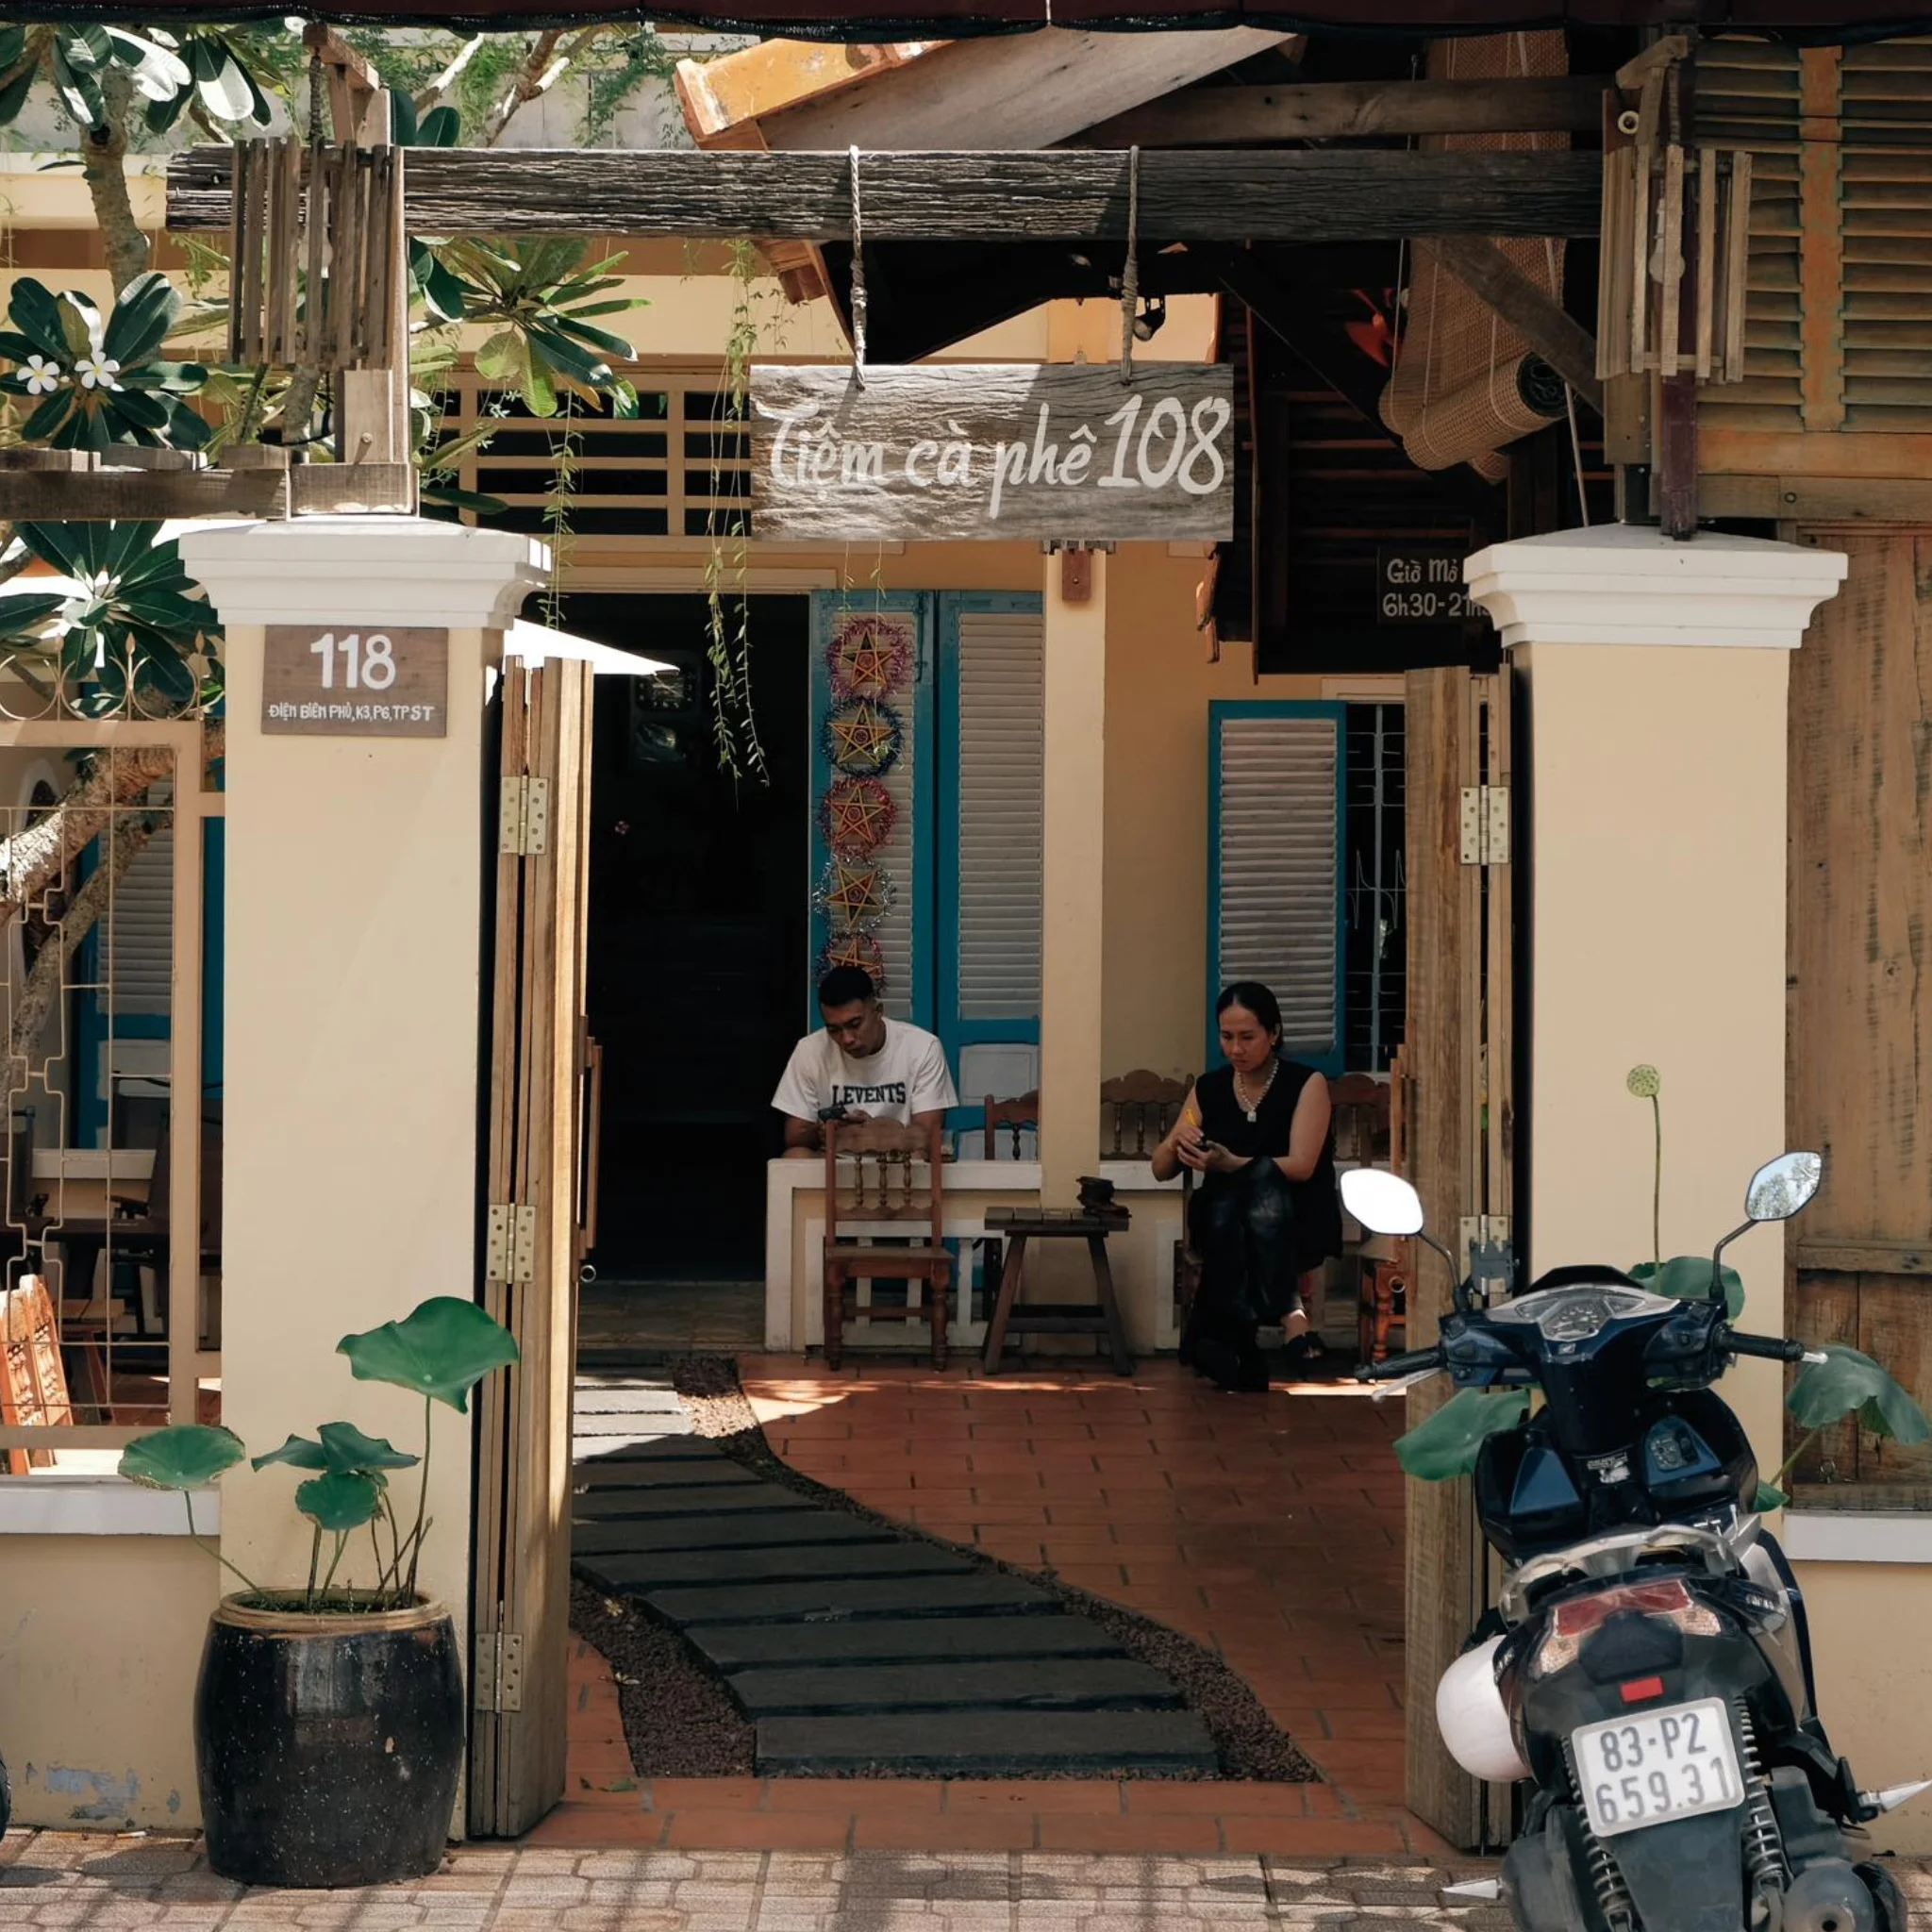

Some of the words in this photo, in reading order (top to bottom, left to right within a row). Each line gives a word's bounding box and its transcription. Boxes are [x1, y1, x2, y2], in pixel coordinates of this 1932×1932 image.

[756, 401, 892, 501] Tiệm
[905, 419, 970, 488] cà
[988, 402, 1097, 519] phê
[1098, 393, 1231, 494] 108
[1382, 591, 1491, 618] 6h30-21h
[309, 632, 396, 691] 118
[832, 1082, 906, 1106] LEVENTS
[1599, 1712, 1707, 1773] 83-P2
[1595, 1757, 1730, 1824] 659.31
